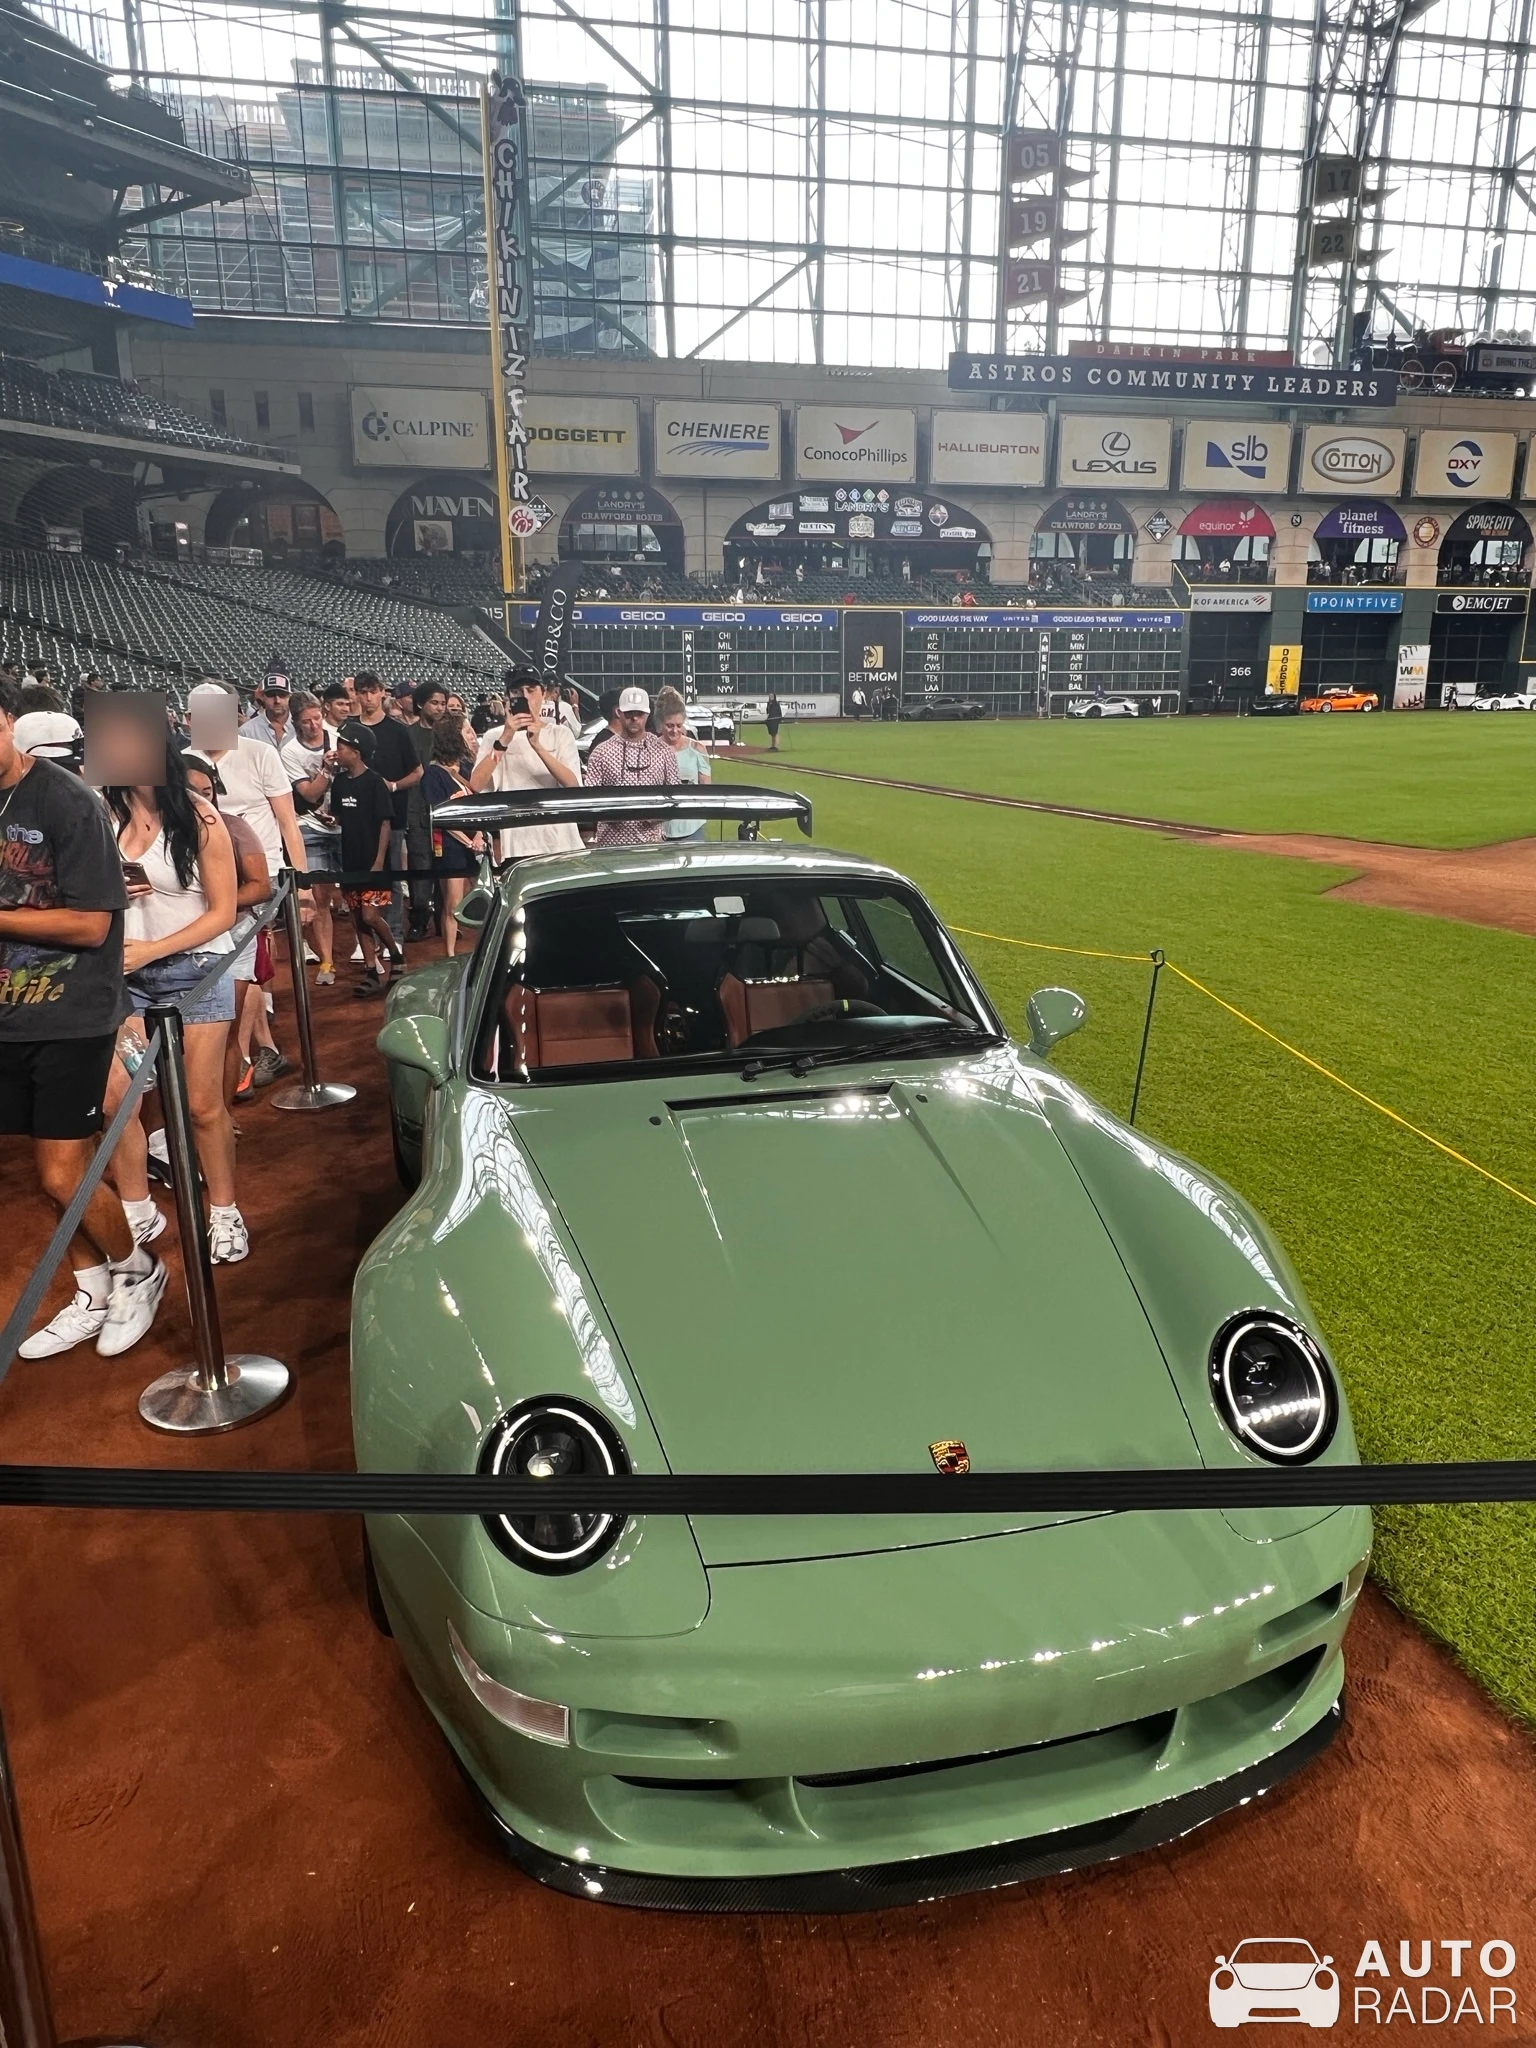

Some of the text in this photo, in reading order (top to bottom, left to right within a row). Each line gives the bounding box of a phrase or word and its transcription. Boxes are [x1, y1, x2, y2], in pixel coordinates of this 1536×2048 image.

[1020, 143, 1050, 169] 05
[1327, 168, 1353, 192] 17
[496, 142, 519, 316] CHIKIN
[1020, 211, 1047, 235] 19
[1320, 234, 1345, 254] 22
[1016, 271, 1042, 294] 21
[1097, 344, 1257, 362] DAIKIN PARK
[968, 362, 1379, 397] ASTROS COMMUNITY LEADERS
[393, 420, 474, 438] CALPINE
[667, 420, 770, 440] CHENIERE
[507, 388, 530, 501] FAIR
[938, 441, 1040, 455] HALLIBURTON
[1231, 435, 1269, 462] slb
[803, 446, 908, 465] ConocoPhillips
[1322, 447, 1382, 474] COTTON
[1072, 459, 1157, 474] LEXUS
[1448, 459, 1481, 470] OXY
[410, 495, 494, 517] MAVEN
[834, 501, 890, 513] LANDRY'S
[1339, 509, 1378, 524] planet
[1466, 515, 1516, 530] SPACE CITY
[1199, 522, 1236, 533] equinor
[1342, 522, 1384, 534] fitness
[1200, 598, 1211, 606] OF
[1213, 598, 1250, 606] AMERICA
[1314, 597, 1397, 608] 1POINTFIVE
[1465, 597, 1513, 613] EMCJET
[621, 611, 665, 621] GEICO
[702, 612, 746, 622] GEICO
[780, 613, 823, 623] GEICO
[917, 615, 938, 623] GOOD
[973, 615, 988, 623] WAY
[927, 633, 939, 641] ATL
[717, 642, 732, 650] MIL
[927, 642, 938, 650] KC
[1069, 642, 1085, 650] MIN
[719, 654, 730, 662] PIT
[1041, 635, 1049, 681] AMERI
[684, 633, 694, 703] NATIONA
[923, 663, 941, 671] CWS
[1230, 667, 1252, 677] 366
[1279, 648, 1290, 695] DOGGET
[1400, 666, 1424, 676] WM
[721, 676, 730, 684] TB
[848, 671, 898, 682] BETMGM
[926, 674, 938, 682] TEX
[717, 686, 734, 694] NYY
[1068, 683, 1082, 691] BAL
[6, 824, 44, 845] the
